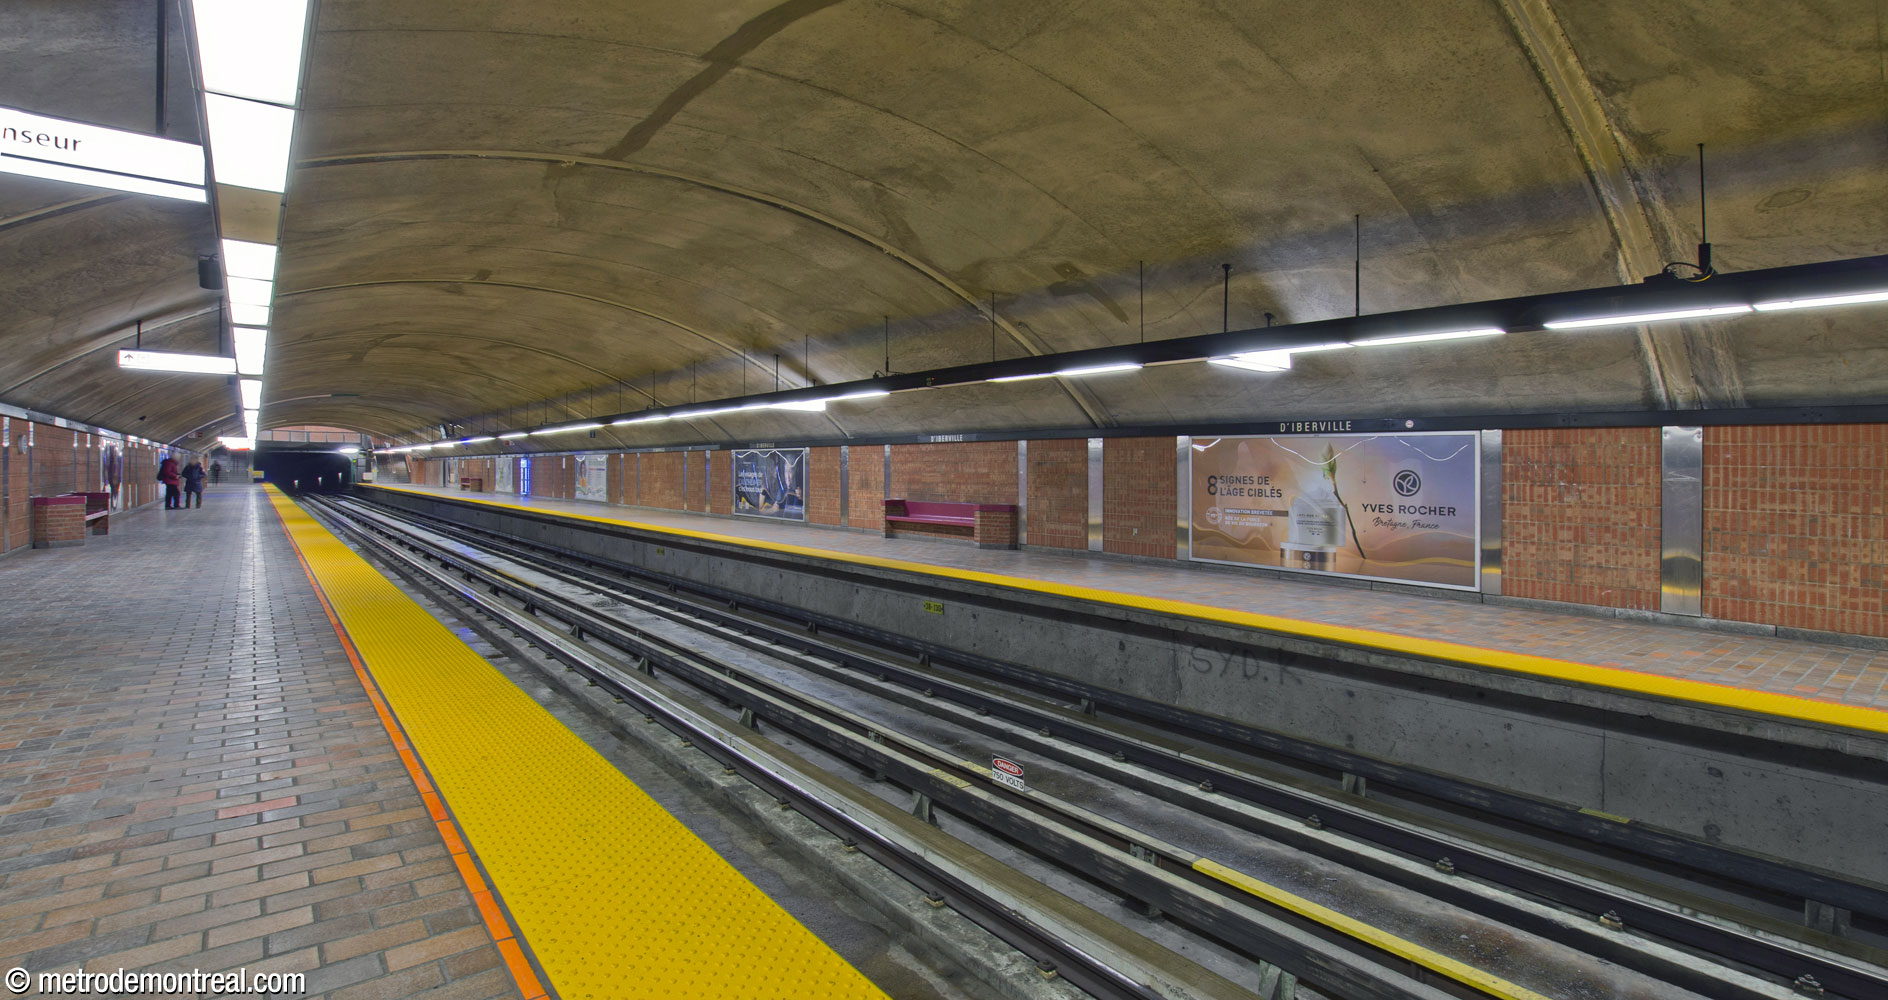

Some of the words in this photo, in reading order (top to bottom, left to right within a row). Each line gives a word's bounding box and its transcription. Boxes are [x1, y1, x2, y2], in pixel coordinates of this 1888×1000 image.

[3, 127, 82, 152] nseur
[1280, 421, 1352, 433] D'IBERVILLE
[1207, 475, 1218, 496] 8
[1219, 475, 1255, 485] SIGNES
[1257, 476, 1270, 486] DE
[1220, 485, 1245, 497] L'ÂGE
[1247, 486, 1283, 498] CIBLÉS
[1361, 503, 1394, 514] YVES
[1398, 504, 1457, 517] ROCHER
[1411, 519, 1441, 530] France
[997, 760, 1019, 775] DANGER
[993, 770, 1004, 781] 750
[1005, 775, 1024, 790] VOLTS
